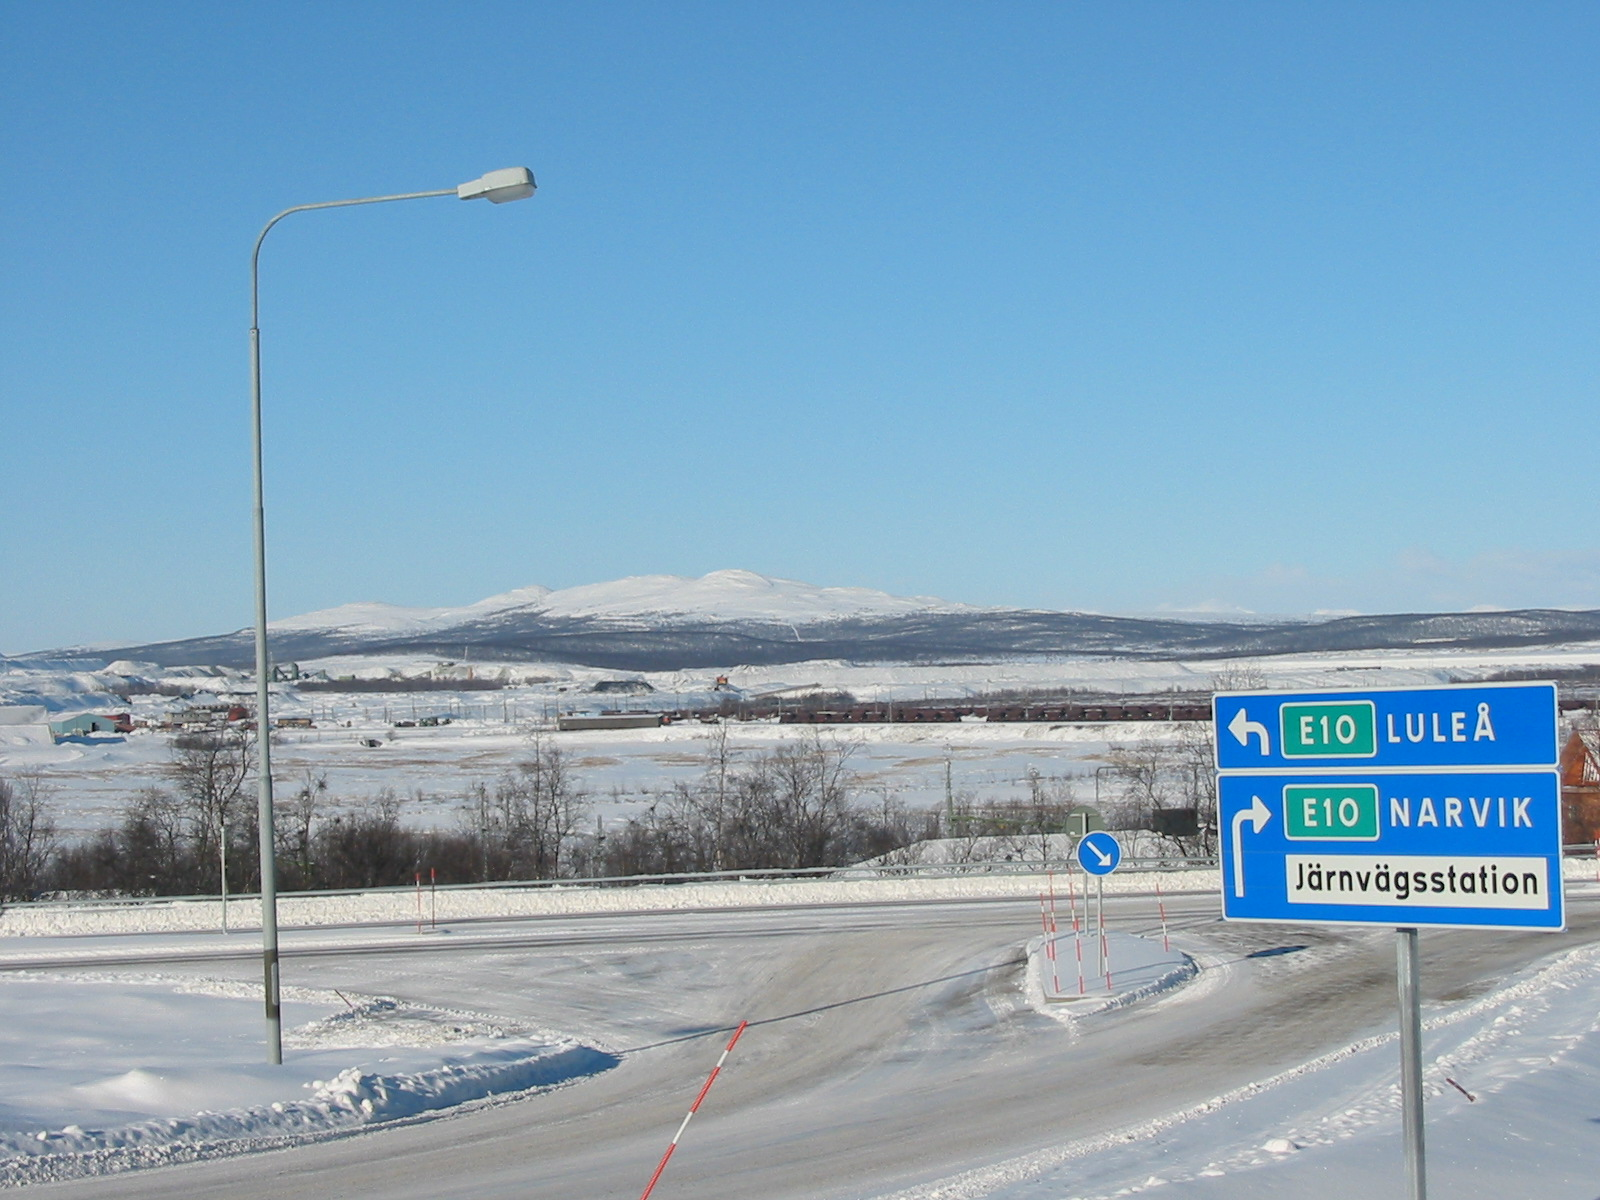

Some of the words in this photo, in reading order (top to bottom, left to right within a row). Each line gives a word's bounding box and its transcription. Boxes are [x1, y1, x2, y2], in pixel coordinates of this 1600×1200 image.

[1300, 715, 1356, 745] E10
[1387, 702, 1496, 743] LULEÅ
[1303, 797, 1360, 827] E10
[1390, 797, 1532, 828] NARVIK
[1296, 863, 1538, 900] Järnvägsstation
